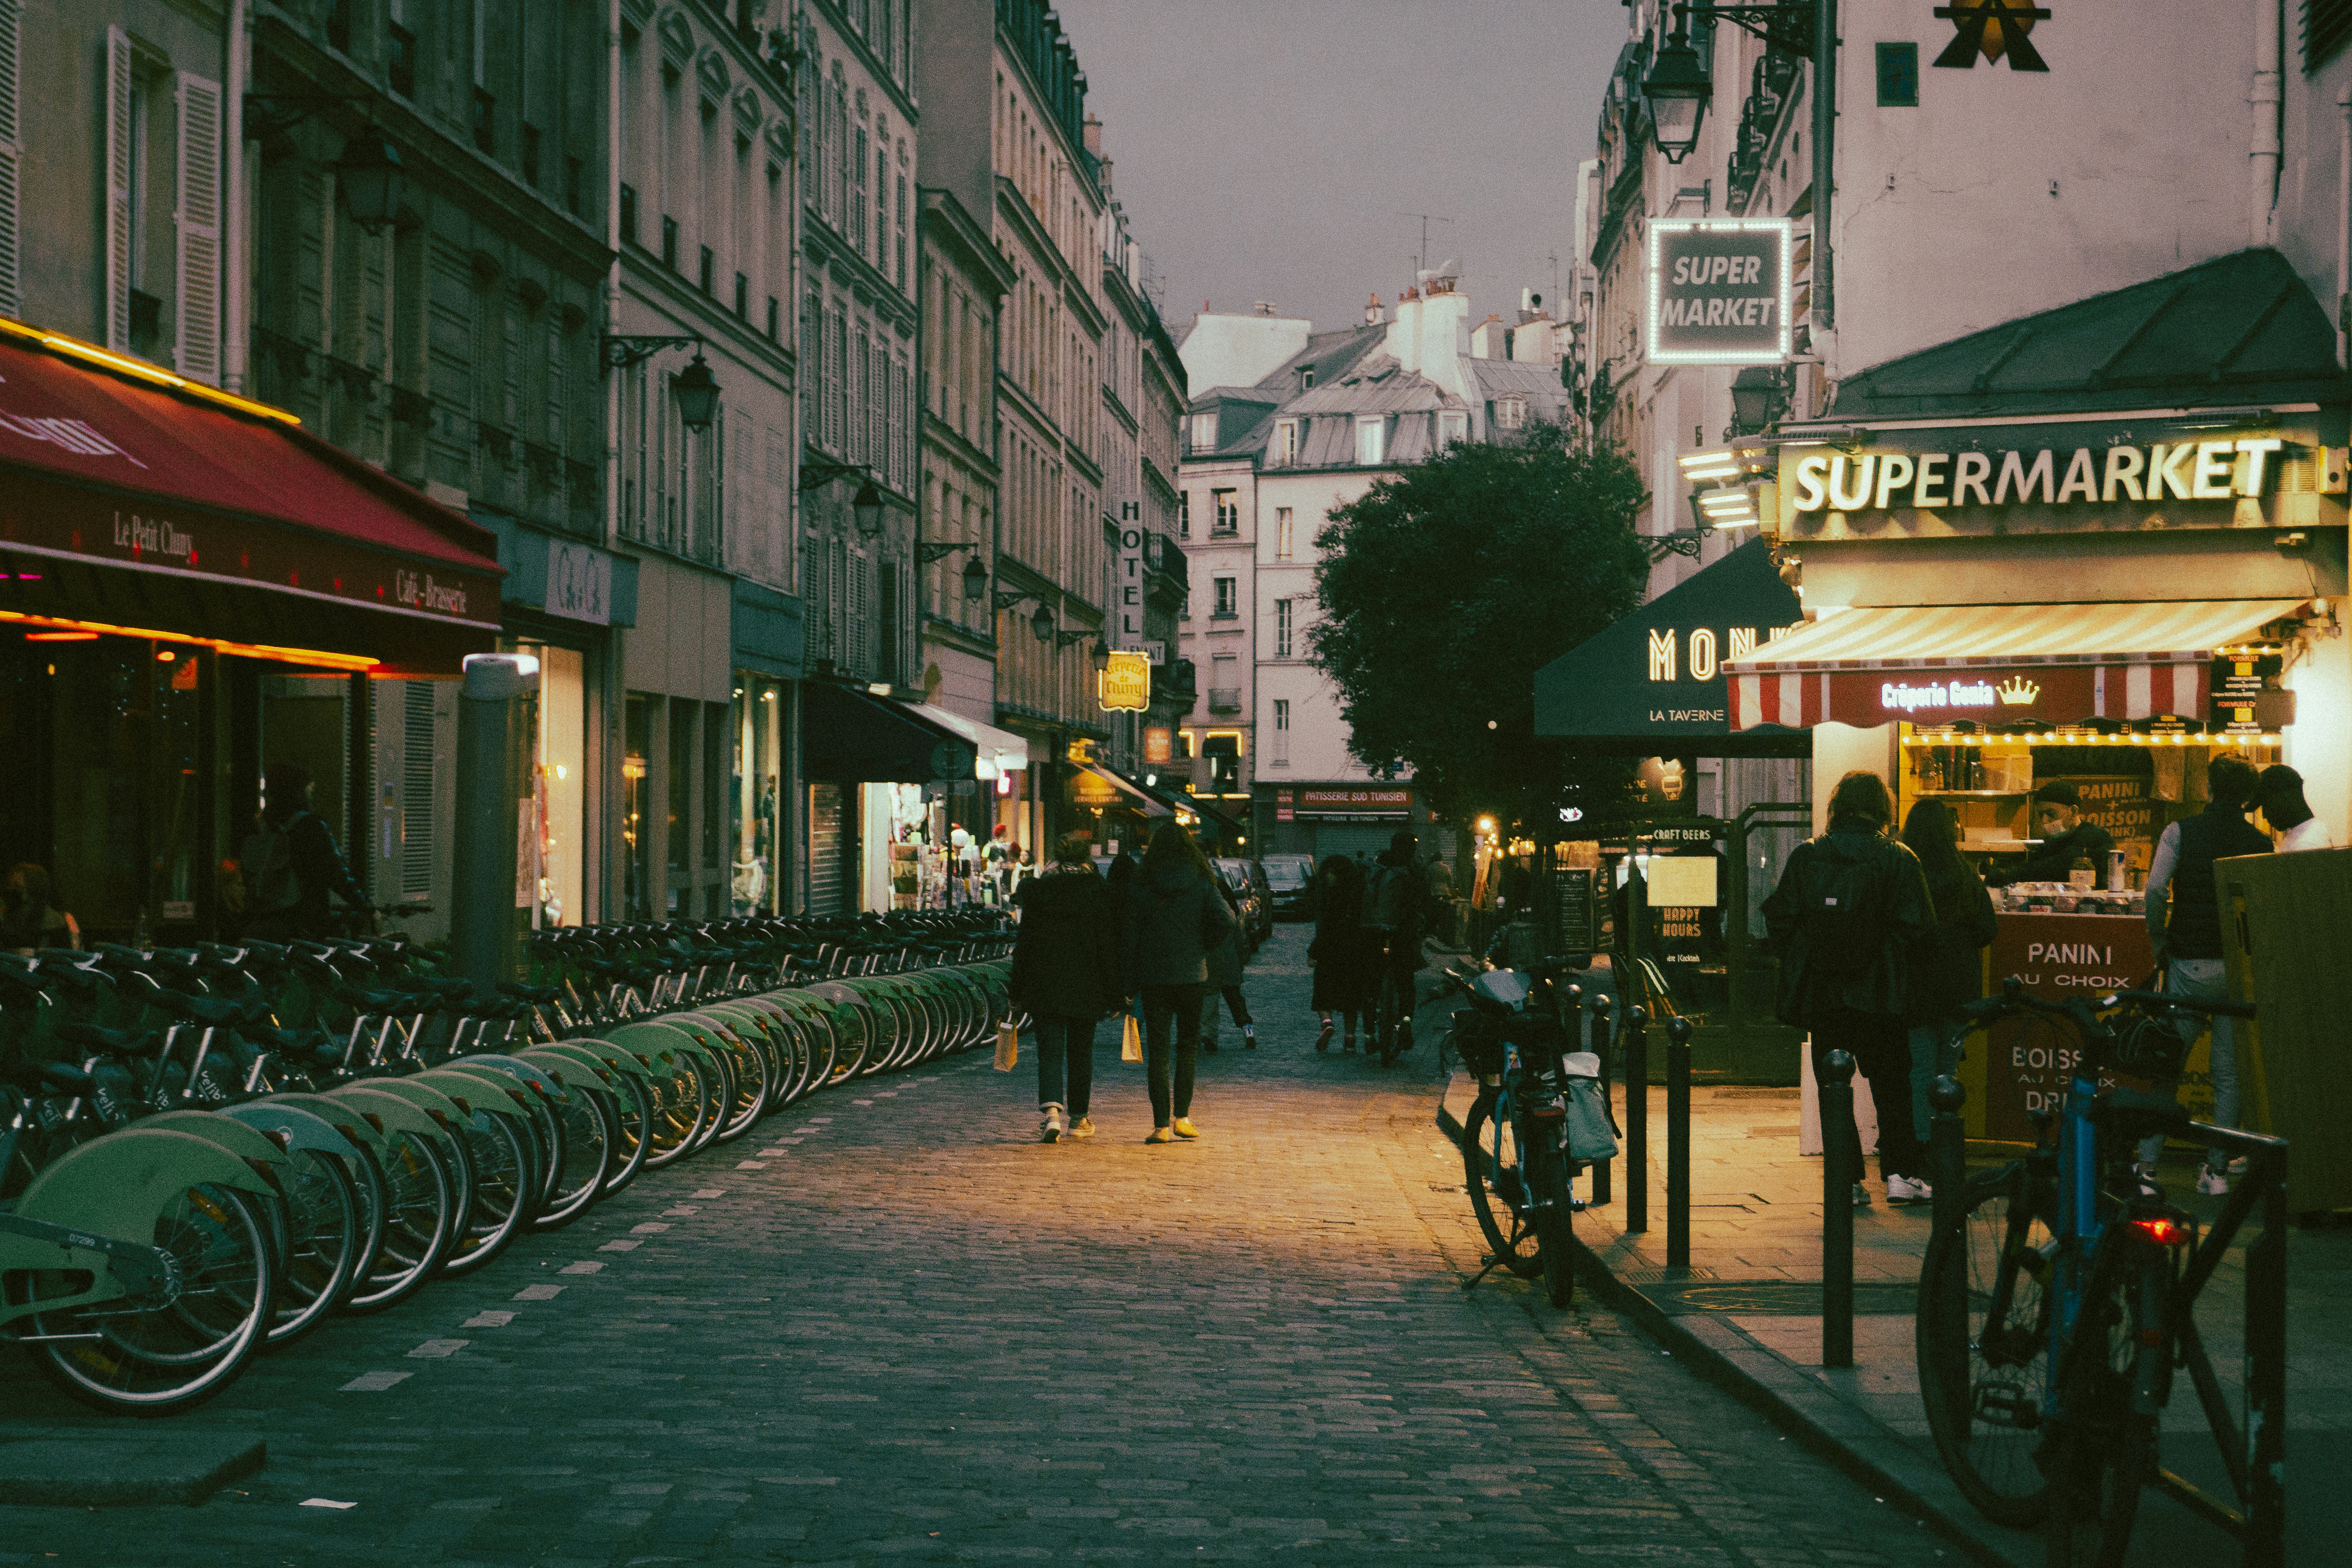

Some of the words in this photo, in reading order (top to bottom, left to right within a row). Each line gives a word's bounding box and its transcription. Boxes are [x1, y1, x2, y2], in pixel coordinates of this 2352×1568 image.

[1672, 256, 1761, 285] SUPER
[1660, 298, 1775, 326] MARKET
[1792, 439, 2281, 511] SUPERMARKET
[114, 511, 129, 547] Le
[133, 515, 157, 552] Petit
[1122, 501, 1141, 633] HOTEL
[1650, 710, 1665, 721] LA
[1668, 710, 1724, 721] TAVERNE
[1305, 791, 1349, 801] PATISSERIE
[1352, 792, 1368, 802] SUD
[1370, 792, 1407, 802] TUNISIEN
[2078, 783, 2140, 800] PANINI
[1654, 829, 1680, 840] CRAFT
[1682, 829, 1711, 840] BEERS
[1663, 907, 1700, 921] HAPPY
[1663, 923, 1701, 937] HOURS
[2028, 943, 2112, 965] PANINI
[2004, 973, 2040, 985] AU
[2054, 975, 2129, 988] CHOIX
